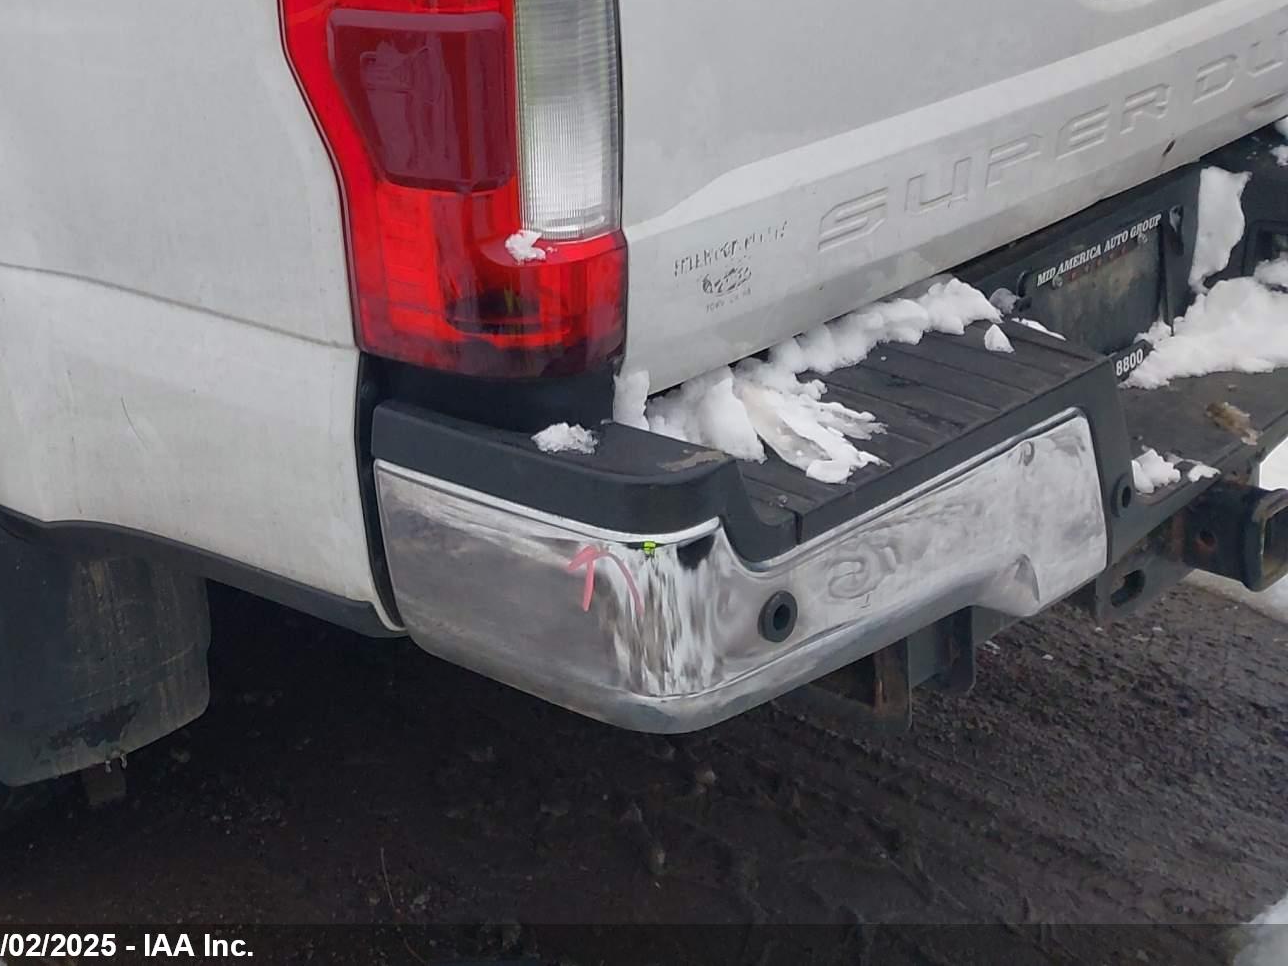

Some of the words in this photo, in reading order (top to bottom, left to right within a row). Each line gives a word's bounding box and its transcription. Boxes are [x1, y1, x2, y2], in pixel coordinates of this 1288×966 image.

[817, 83, 1171, 252] SUPER
[1036, 267, 1056, 287] MID
[1057, 245, 1102, 275] AMERICA
[1103, 230, 1129, 253] AUTO
[1129, 213, 1162, 238] GROUP
[1115, 348, 1144, 377] 8800
